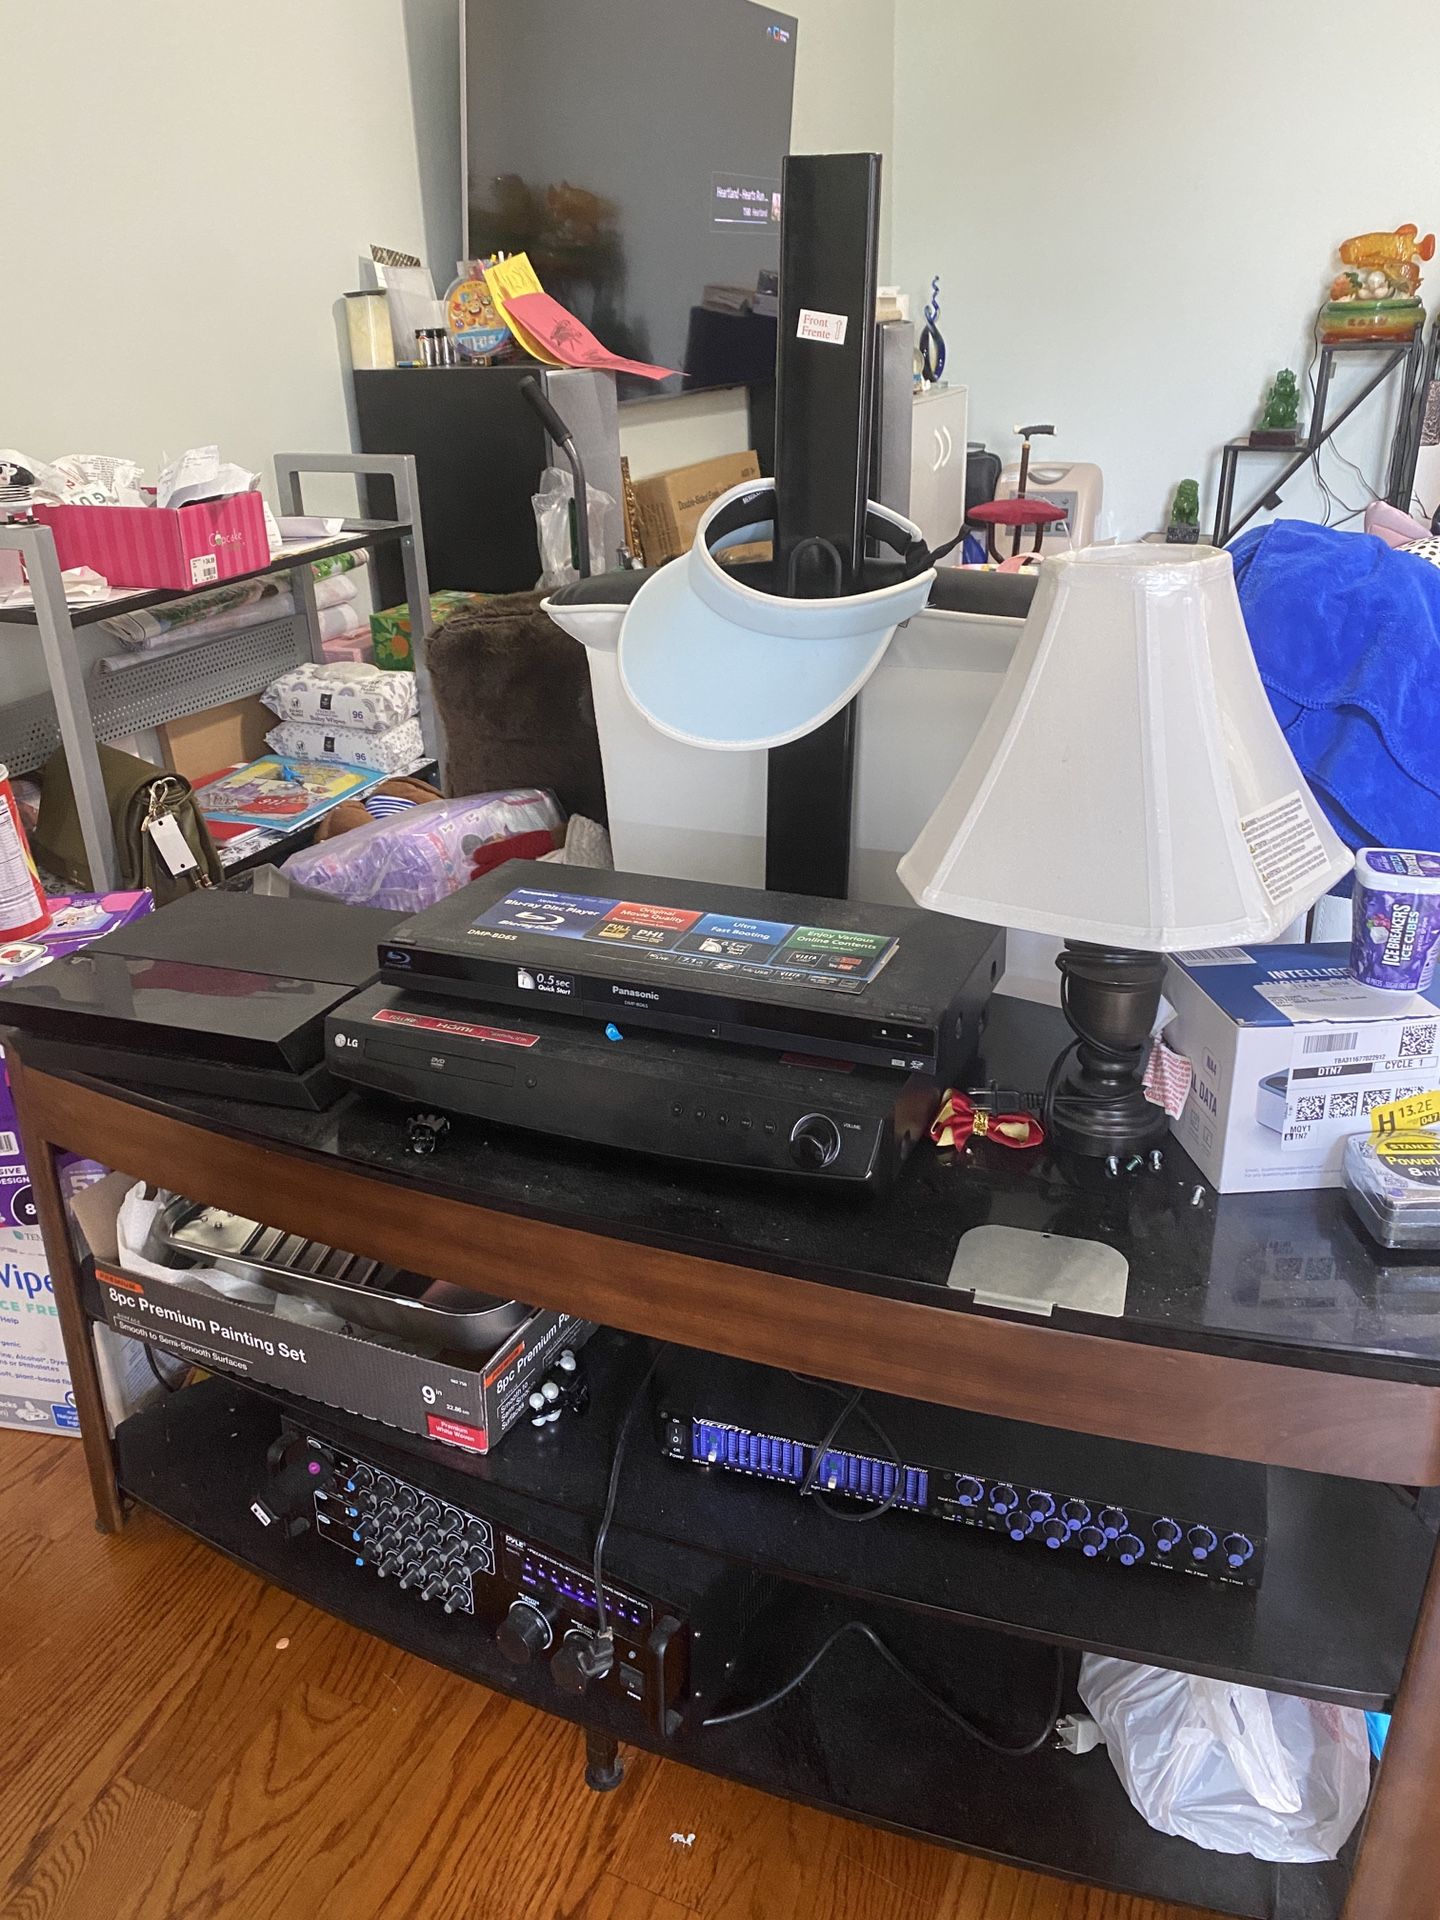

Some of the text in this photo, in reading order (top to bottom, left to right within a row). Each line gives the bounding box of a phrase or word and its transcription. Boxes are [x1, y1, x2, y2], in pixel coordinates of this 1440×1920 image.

[803, 314, 828, 327] Front
[801, 325, 831, 339] Frente
[352, 710, 363, 720] 96
[355, 752, 367, 762] 96
[504, 899, 601, 916] Blu-ray Disc Player
[639, 907, 677, 916] Original
[620, 909, 650, 918] Movie
[651, 913, 686, 924] Quality
[710, 926, 771, 940] Fast Booting
[733, 921, 757, 930] Ultra
[466, 928, 518, 942] DMP-BD65
[806, 930, 875, 944] Enjoy Various
[1382, 903, 1412, 967] ICE BREAKERS
[1400, 911, 1420, 961] ICE CUBES
[796, 936, 831, 945] Online
[831, 939, 877, 950] Contents
[536, 973, 570, 988] 0.5 sec
[537, 984, 571, 996] Quick Start
[612, 985, 660, 1001] Panasonic
[436, 1022, 475, 1033] HDMI
[347, 1038, 359, 1048] LG
[1317, 1066, 1343, 1076] DTN7
[1384, 1059, 1413, 1070] CYCLE
[1200, 1077, 1218, 1117] DATA
[1398, 1099, 1433, 1118] 13.2E
[1376, 1110, 1396, 1138] H
[1420, 1113, 1439, 1126] 047
[24, 1203, 37, 1215] 8
[108, 1287, 308, 1364] 8pc Premium Painting Set
[119, 1321, 248, 1371] Smooth to Semi-Smooth Surfaces
[495, 1370, 516, 1395] 8pc
[517, 1324, 557, 1374] Premium
[421, 1385, 443, 1405] 9 in
[500, 1389, 521, 1414] Smooth
[501, 1402, 526, 1431] Surfaces
[435, 1425, 475, 1442] White Woven
[440, 1420, 469, 1435] Premium
[692, 1416, 752, 1435] VocoPro
[842, 1450, 855, 1459] Echo
[902, 1464, 928, 1474] Equalizer
[505, 1534, 525, 1549] PYLE
